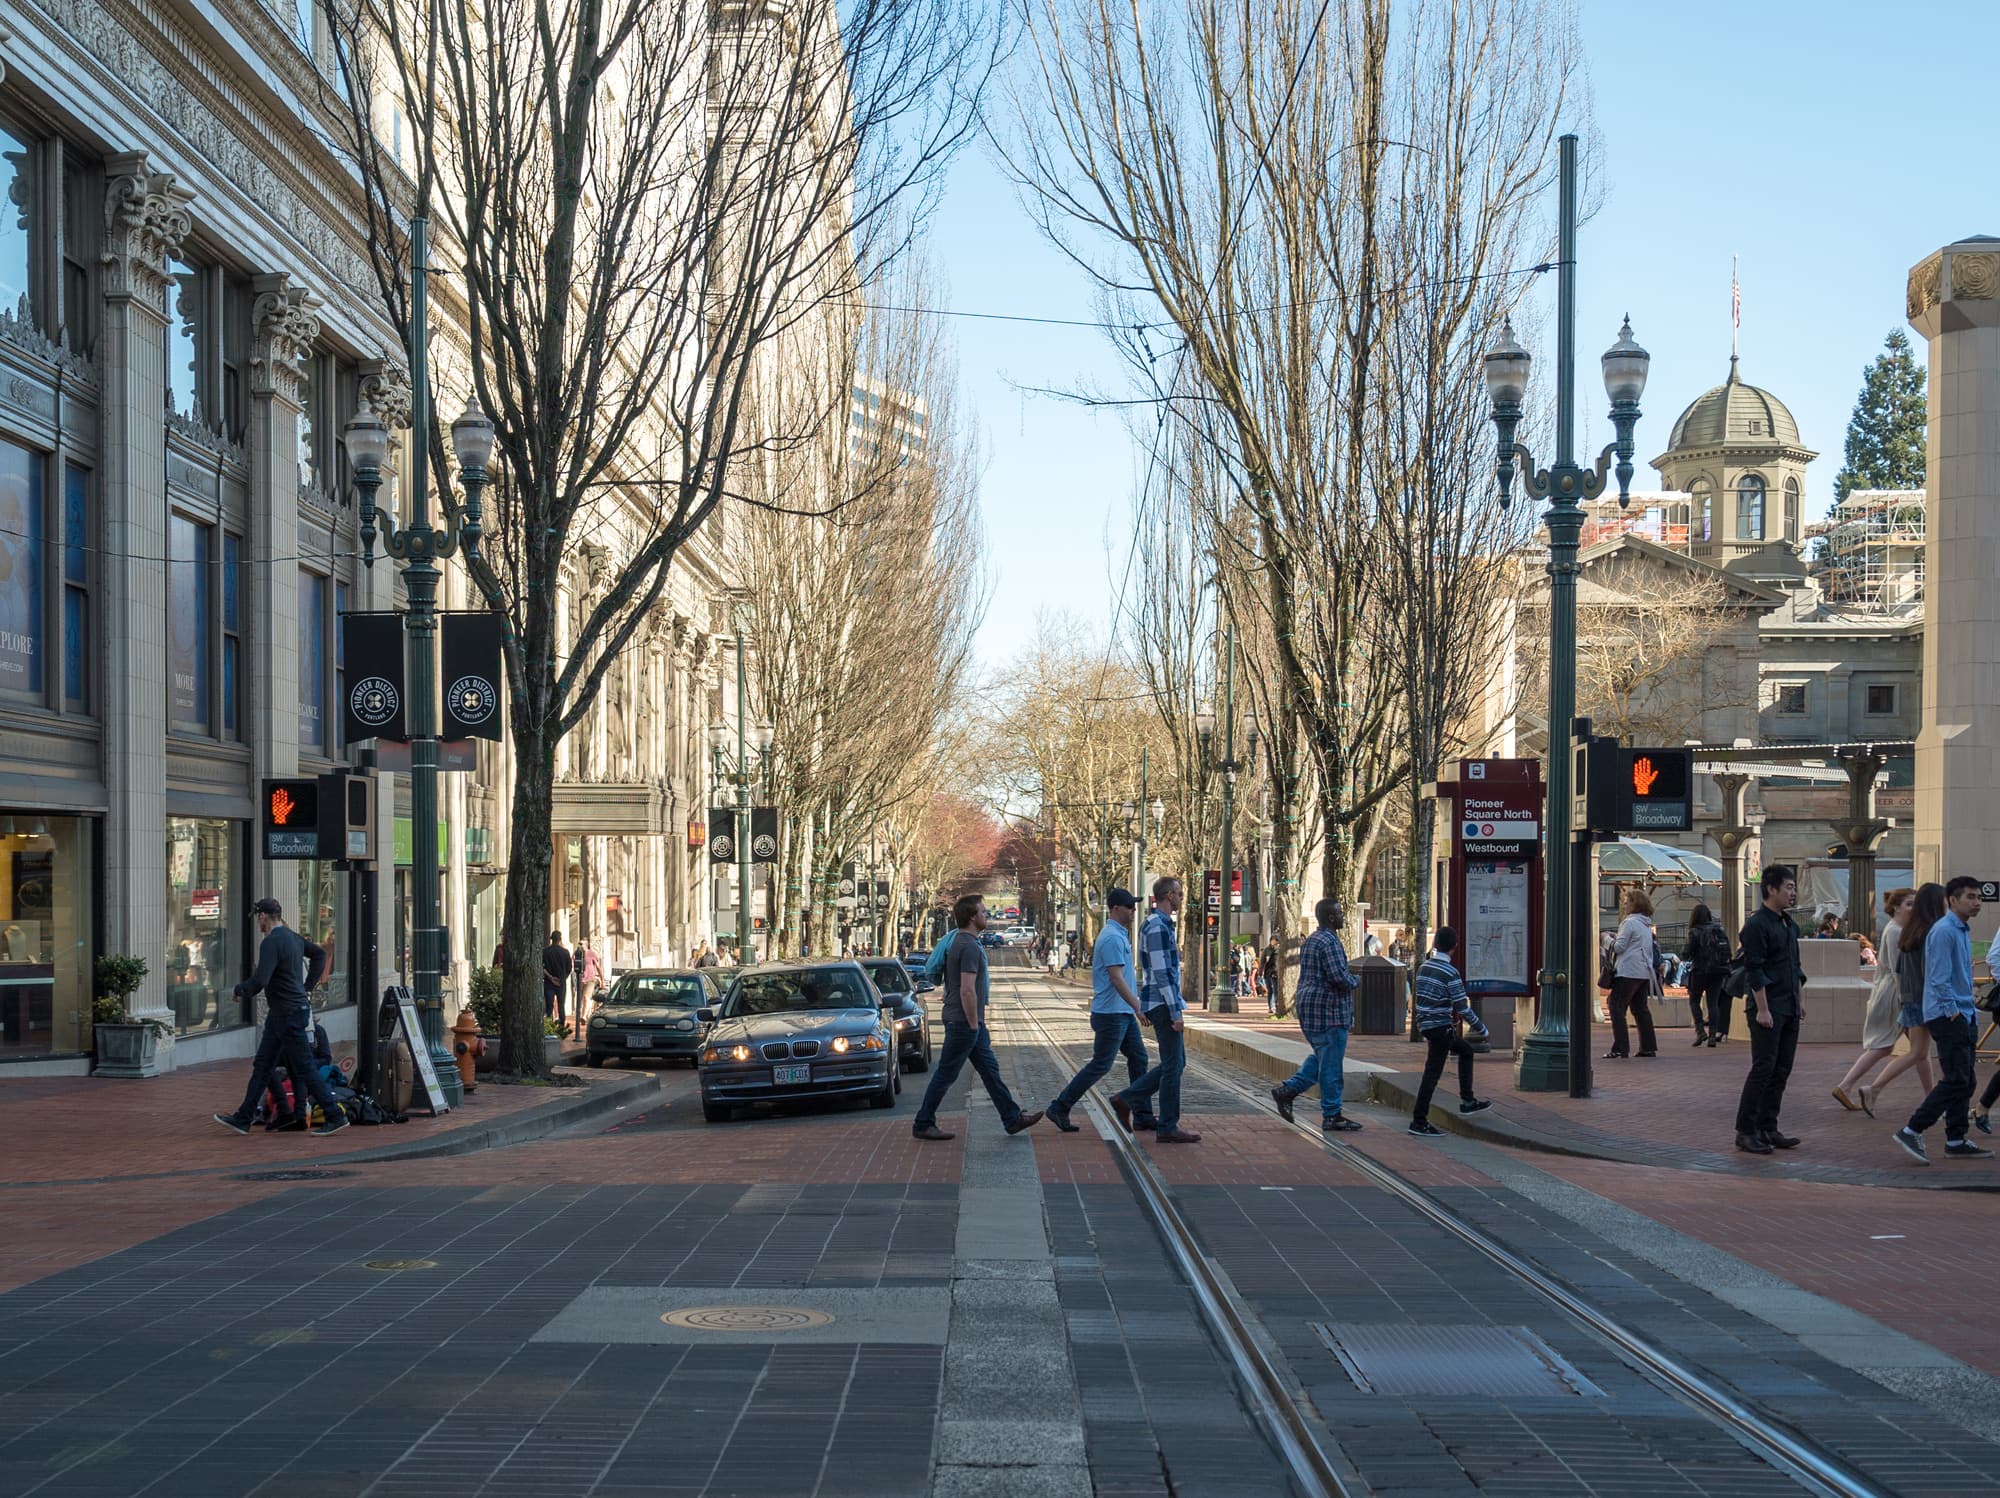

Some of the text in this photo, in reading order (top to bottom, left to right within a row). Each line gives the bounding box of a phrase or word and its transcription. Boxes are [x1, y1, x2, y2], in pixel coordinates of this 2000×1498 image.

[0, 631, 33, 655] PLORE
[353, 680, 396, 709] PIONEER DISTRICT
[451, 679, 493, 708] PIONEER DISTRICT
[1465, 799, 1505, 808] Pioneer
[1635, 805, 1649, 813] SW
[1465, 810, 1532, 819] Square North
[1635, 814, 1682, 825] Broadway
[271, 834, 284, 842] SW
[271, 843, 314, 855] Broadway
[1465, 843, 1520, 853] Westbound
